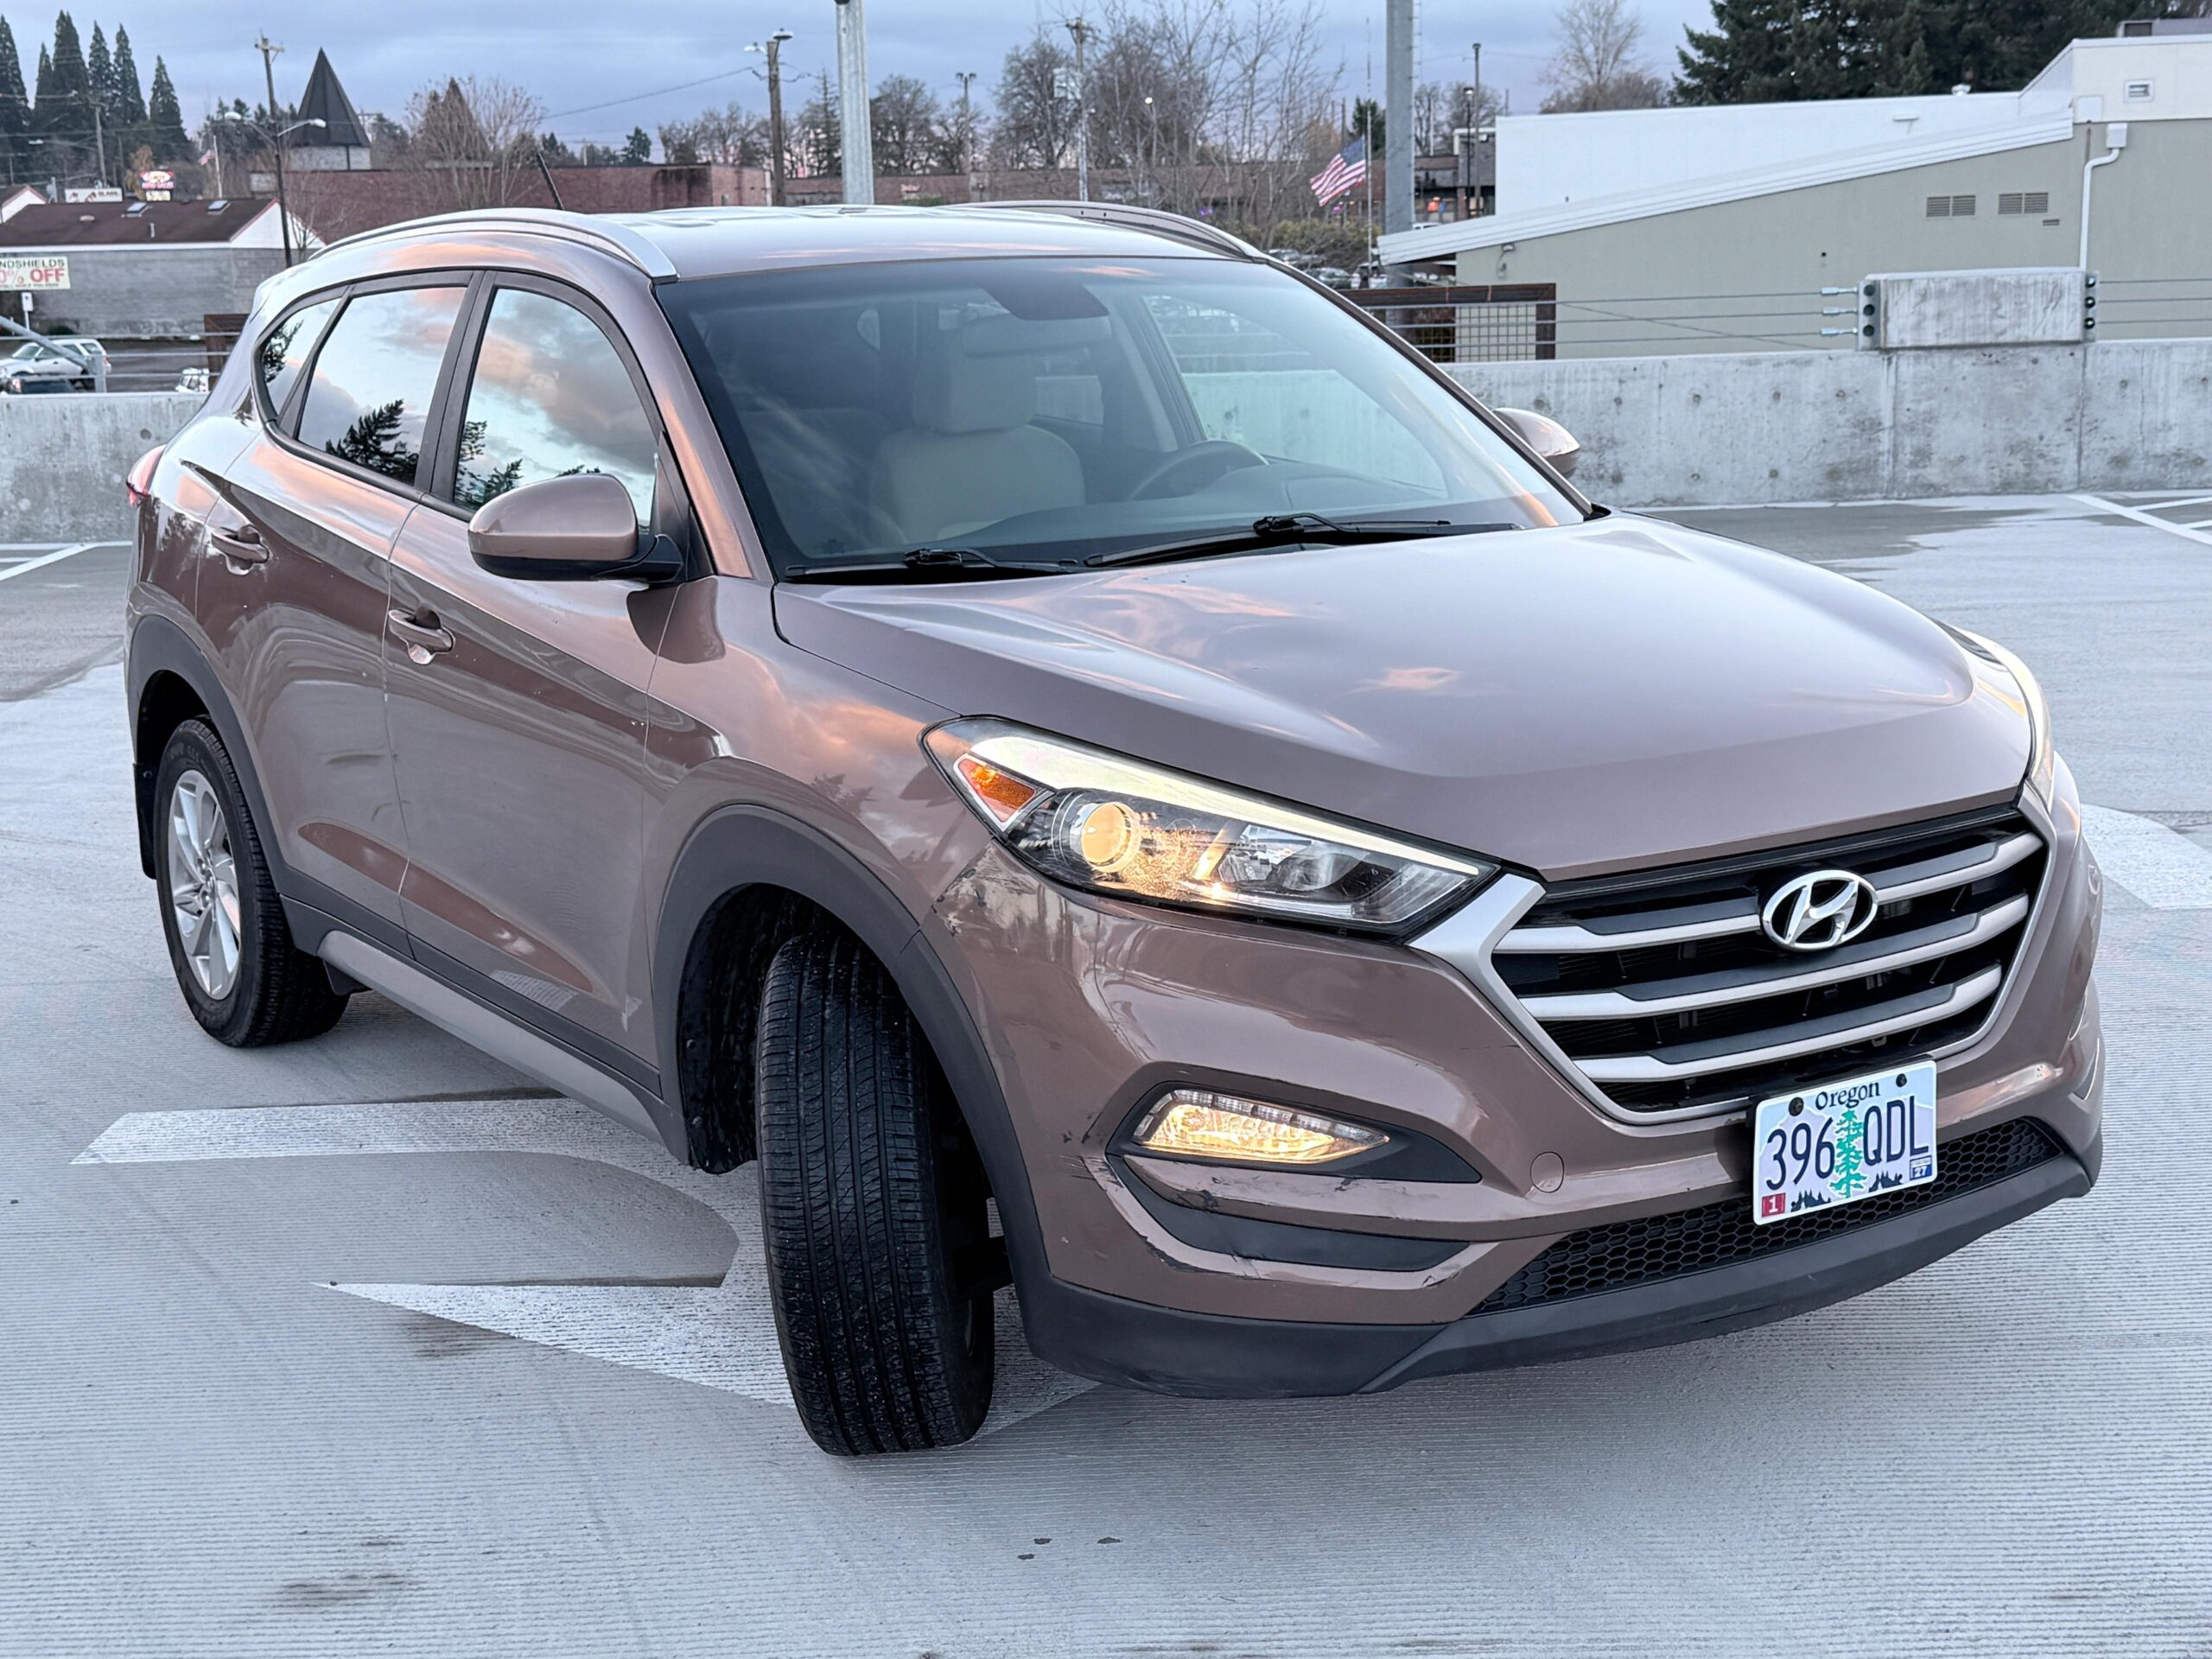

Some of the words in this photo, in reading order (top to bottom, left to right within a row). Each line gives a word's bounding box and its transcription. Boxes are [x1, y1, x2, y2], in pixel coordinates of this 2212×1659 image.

[29, 268, 65, 283] OFF
[1815, 1082, 1880, 1111] Oregon
[1765, 1116, 1835, 1191] 396
[1863, 1095, 1929, 1166] QDL
[1913, 1166, 1927, 1179] 27
[1769, 1196, 1779, 1214] 1
